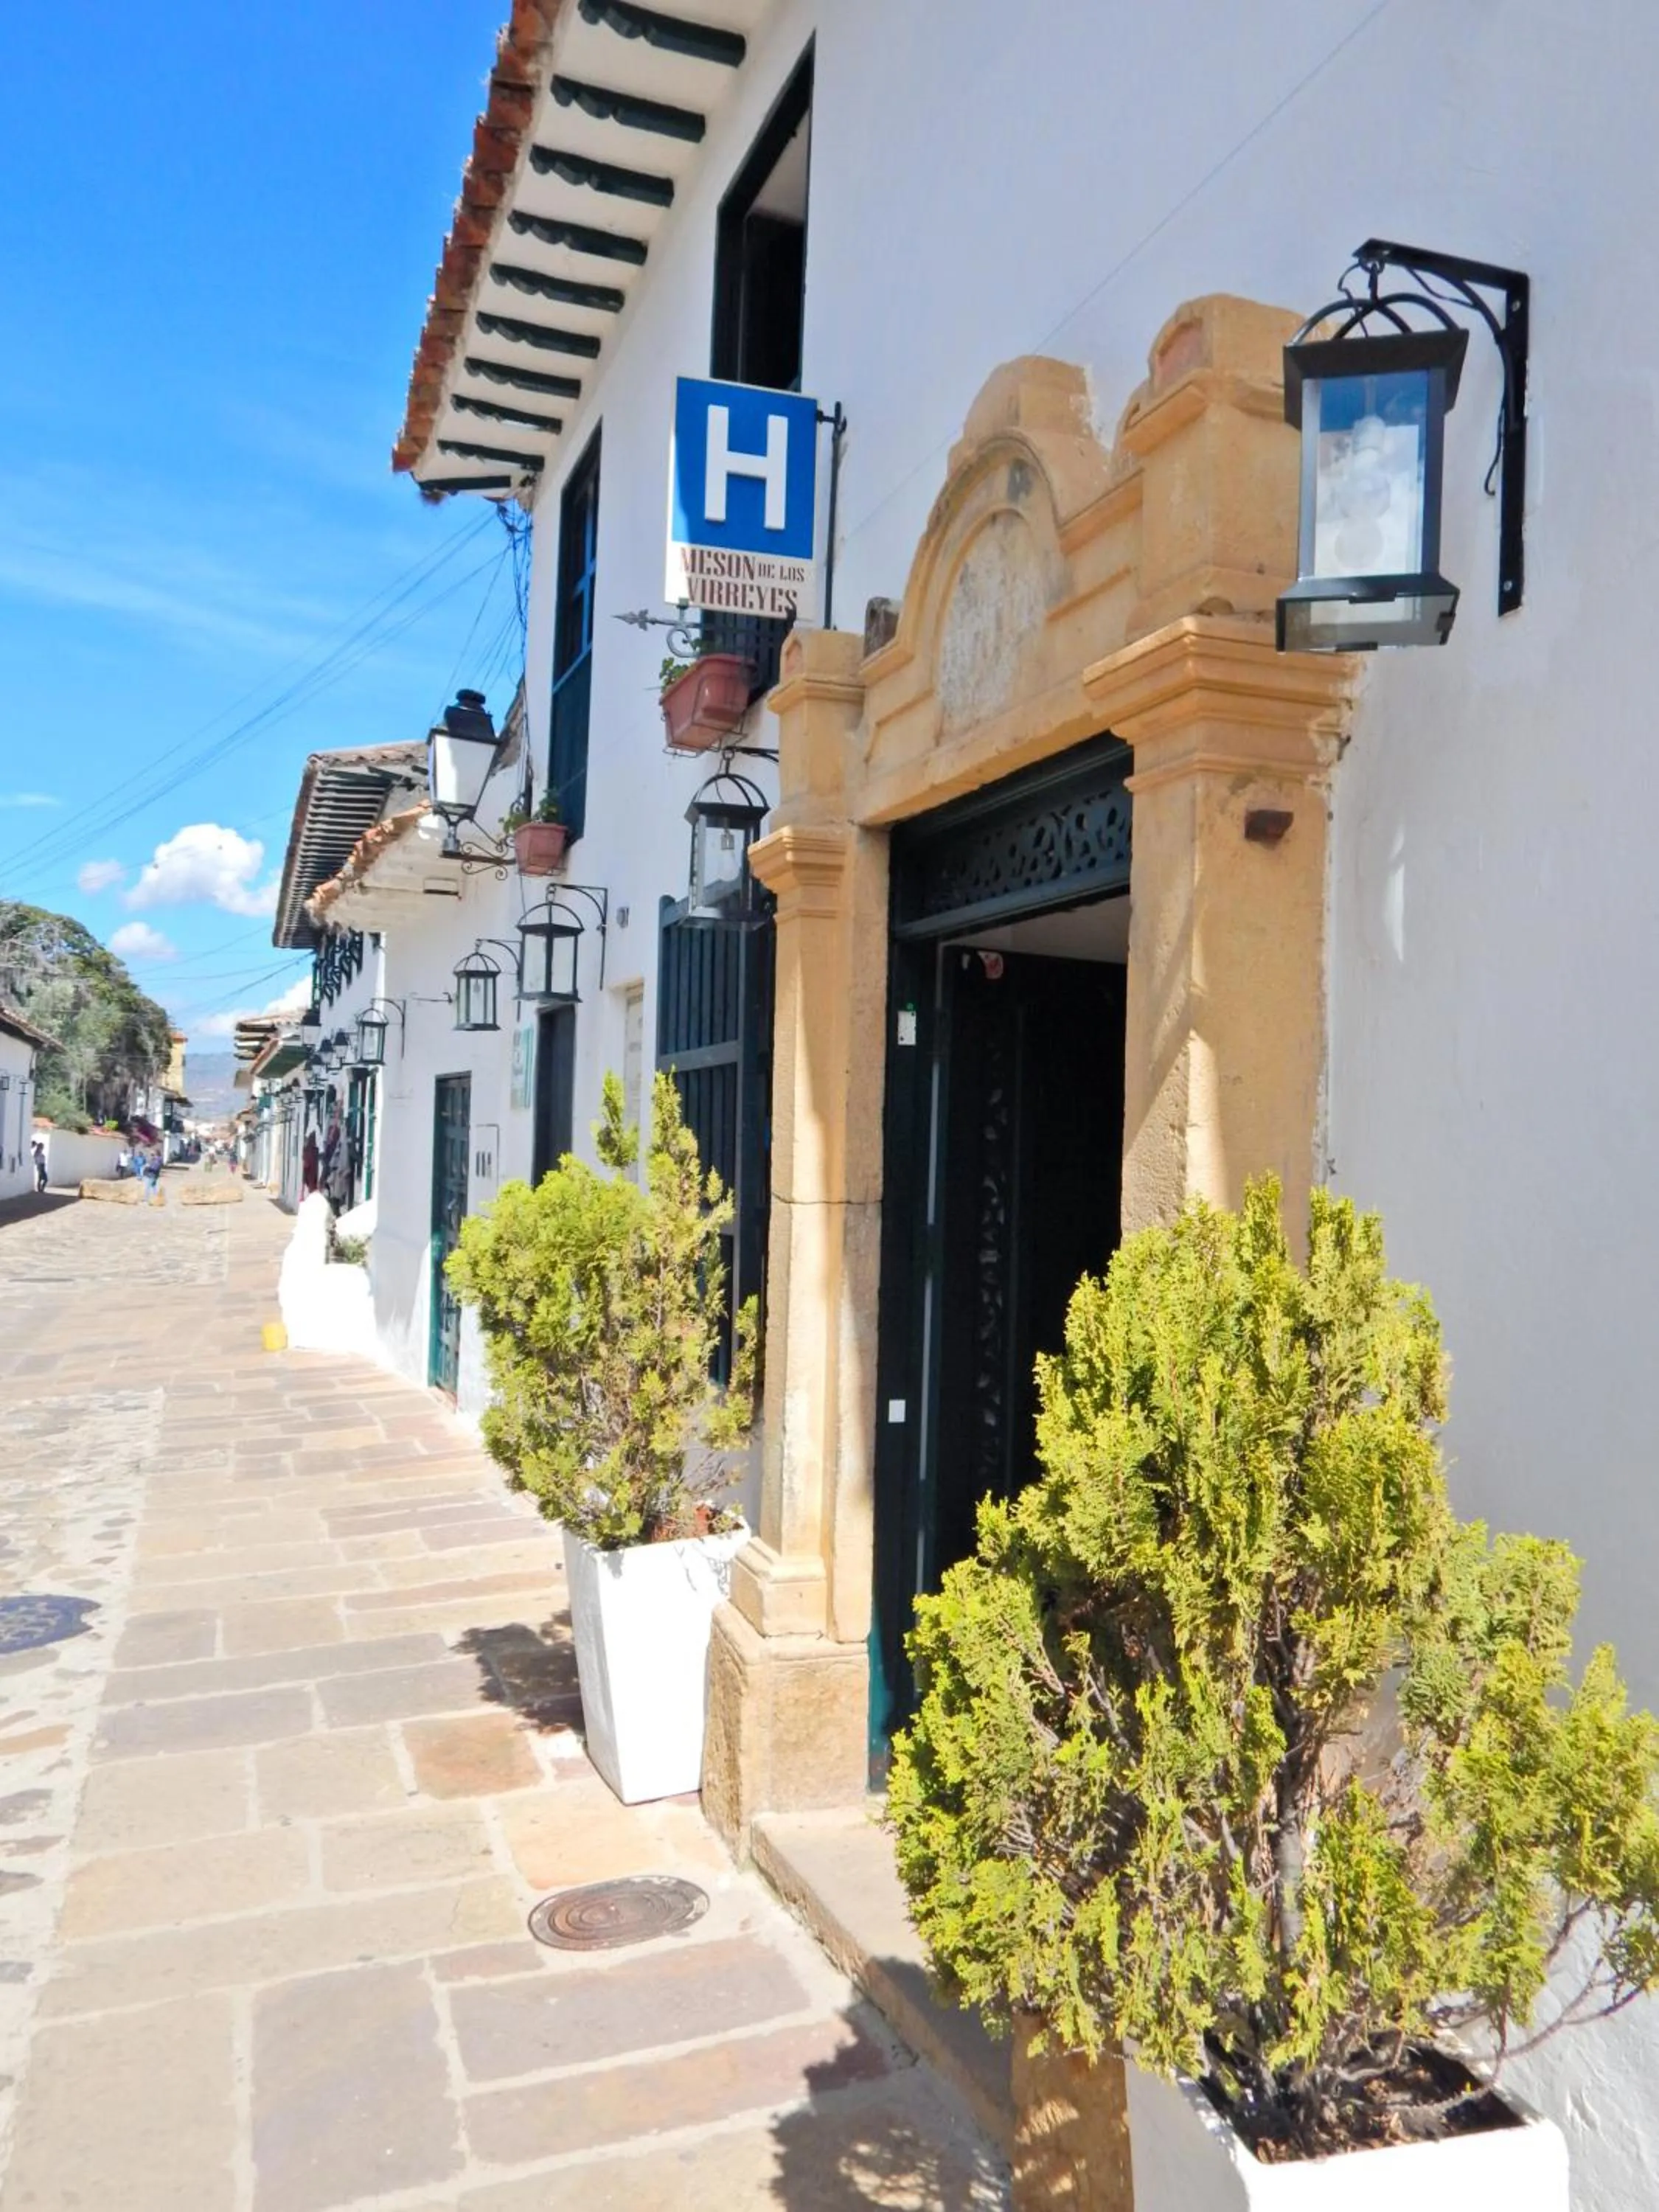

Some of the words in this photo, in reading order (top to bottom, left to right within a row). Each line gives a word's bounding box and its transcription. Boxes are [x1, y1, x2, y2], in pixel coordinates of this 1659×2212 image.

[704, 404, 788, 530] H
[681, 547, 756, 580] MESON
[758, 562, 775, 578] DE
[779, 563, 805, 582] LOS
[687, 576, 797, 613] VIRREYES
